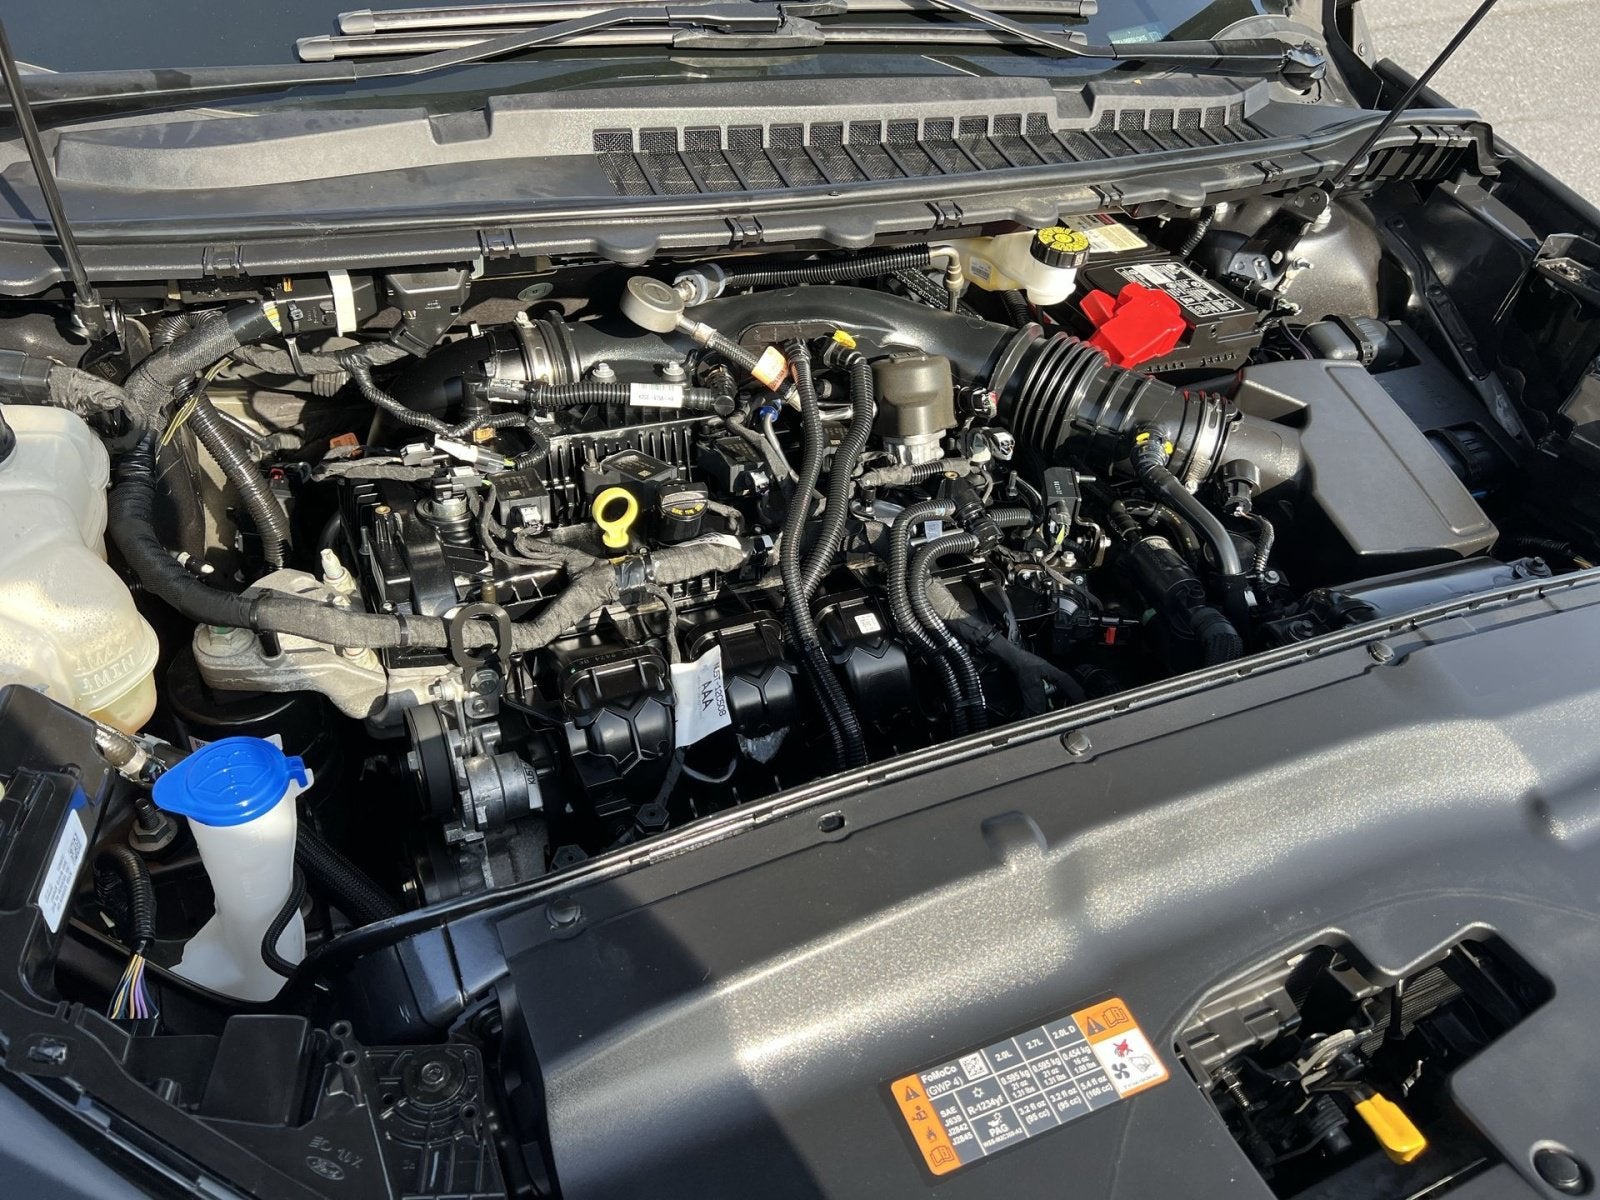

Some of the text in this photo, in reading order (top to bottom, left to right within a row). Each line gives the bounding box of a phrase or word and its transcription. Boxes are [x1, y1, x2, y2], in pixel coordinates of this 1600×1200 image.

[701, 680, 714, 711] AAA
[1052, 1028, 1069, 1039] 2.0L
[1026, 1039, 1043, 1049] 2.7L
[995, 1050, 1013, 1062] 2.0L
[1050, 1054, 1062, 1066] kg
[921, 1066, 957, 1083] FoMoCo
[1019, 1067, 1031, 1078] kg
[926, 1080, 951, 1098] (GWP
[1080, 1080, 1092, 1090] 5.4
[1101, 1083, 1113, 1092] cc)
[1050, 1093, 1062, 1103] 3.2
[1069, 1096, 1082, 1106] cc)
[967, 1095, 1003, 1115] R-1234yf
[1018, 1105, 1031, 1115] 3.2
[940, 1106, 957, 1118] SAE
[1038, 1108, 1050, 1118] cc)
[989, 1124, 1009, 1137] PAG
